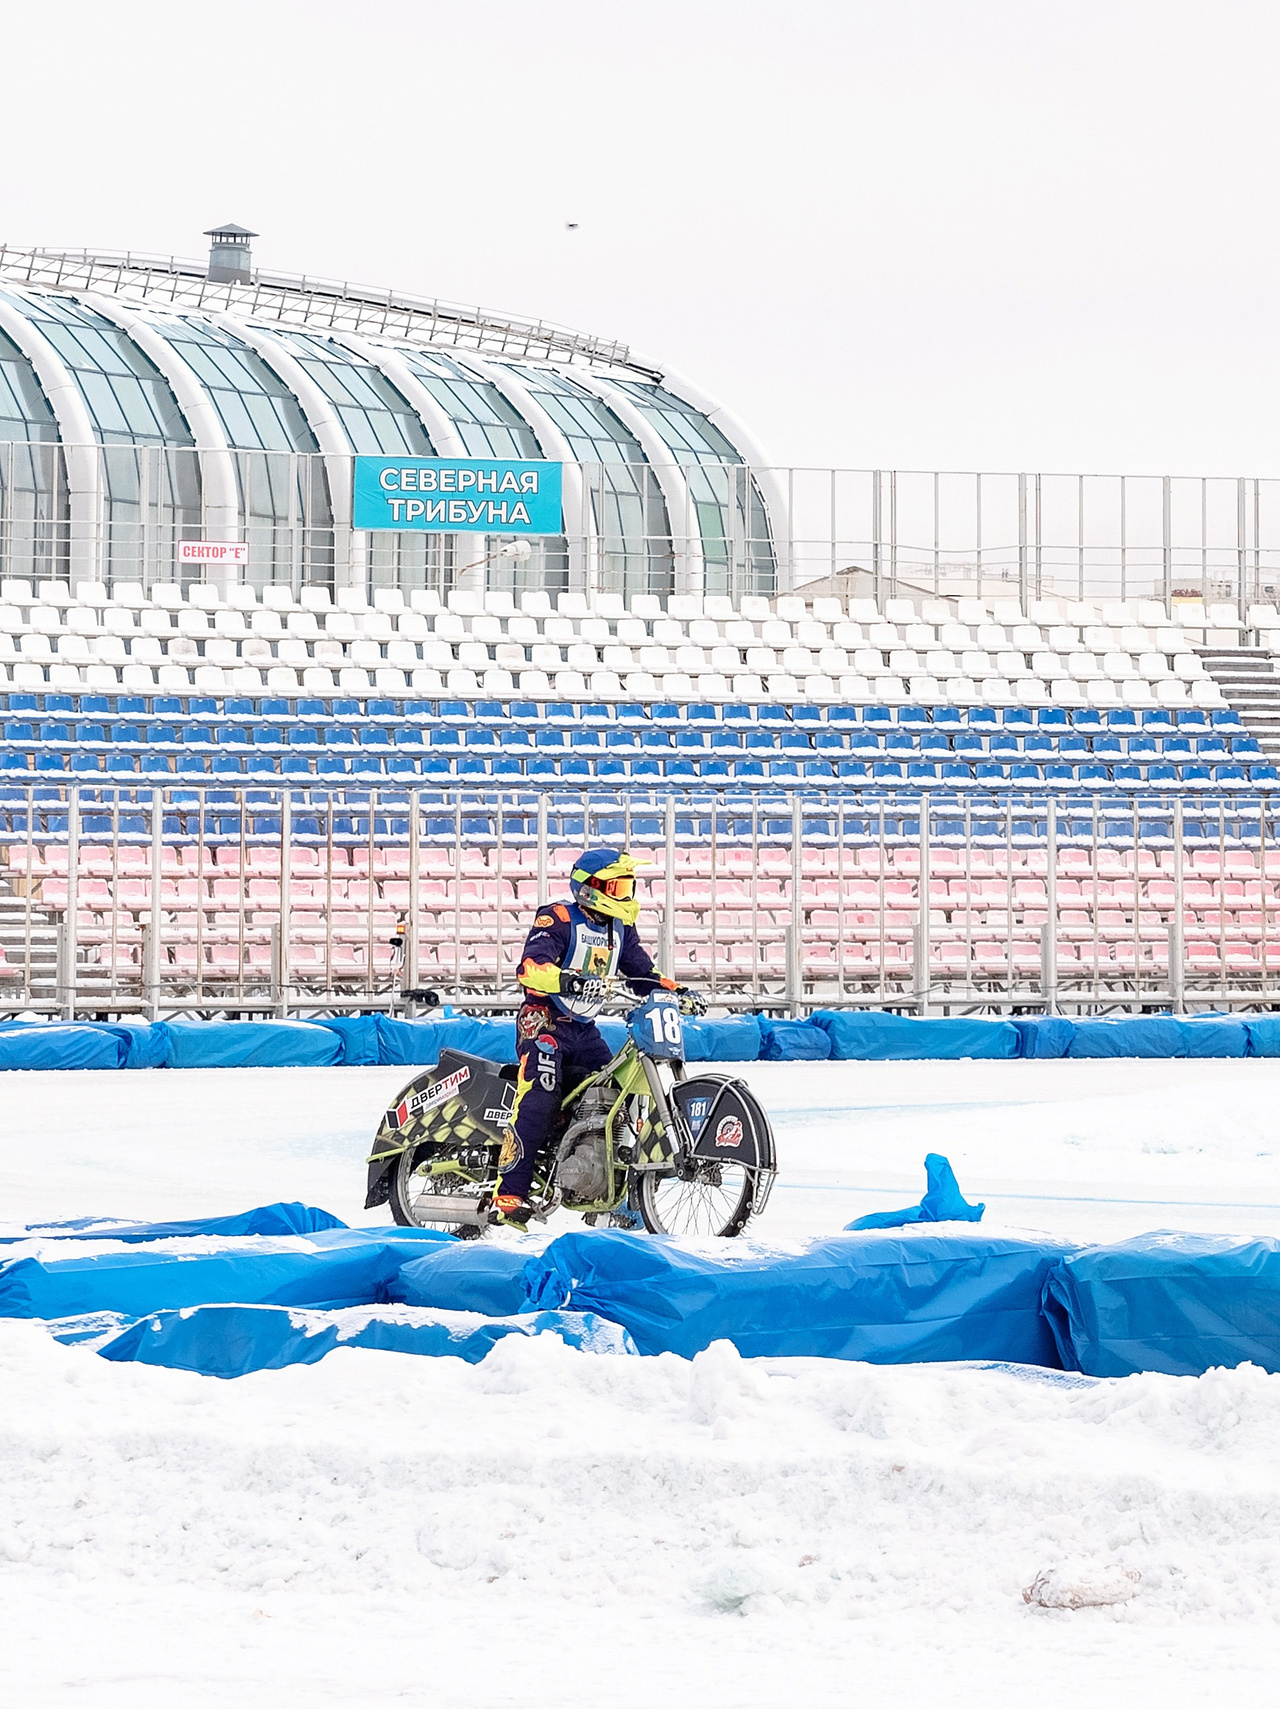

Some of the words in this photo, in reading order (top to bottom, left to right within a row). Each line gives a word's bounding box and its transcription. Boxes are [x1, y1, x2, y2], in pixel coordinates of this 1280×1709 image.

[379, 467, 539, 494] СЕВЕРНАЯ
[387, 498, 532, 525] ТРИБУНА
[183, 545, 227, 559] СЕКТОР
[411, 1068, 469, 1109] ДВЕРТИМ
[486, 1110, 513, 1120] ДВЕР
[690, 1101, 707, 1117] 181
